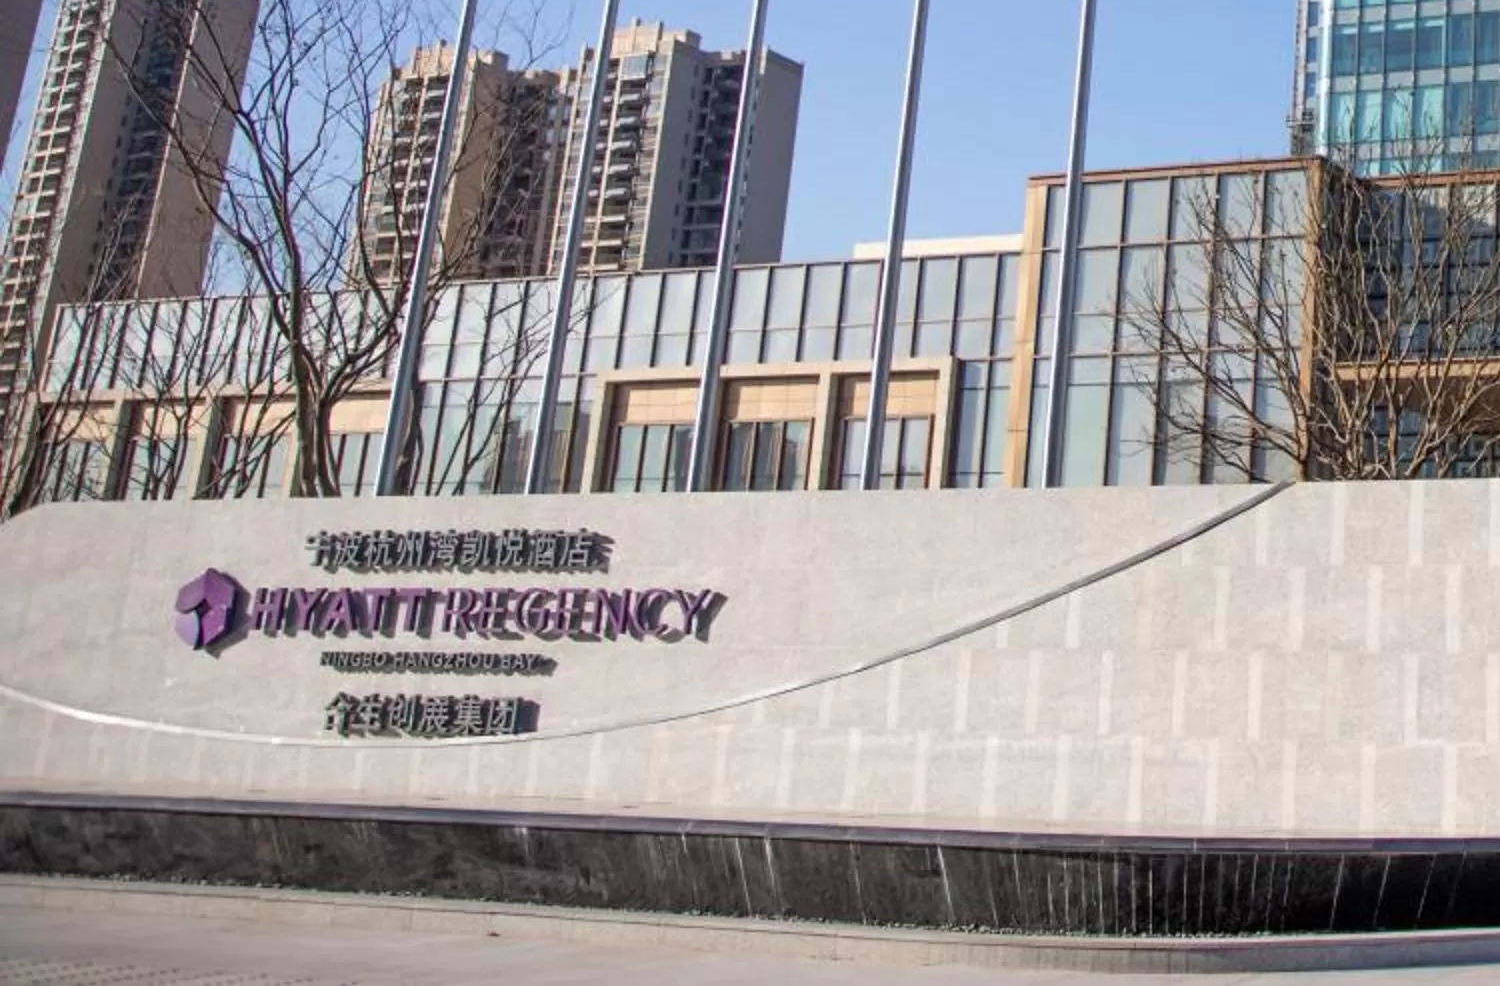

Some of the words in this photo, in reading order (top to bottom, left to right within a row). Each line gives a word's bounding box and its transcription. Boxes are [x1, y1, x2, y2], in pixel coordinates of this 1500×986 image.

[304, 529, 594, 567] 宁波杭州湾凯悦酒店
[250, 587, 433, 633] HYATT
[442, 587, 711, 641] REGENCY
[320, 651, 386, 667] NINGBO
[393, 652, 494, 670] HANGZHOU
[500, 653, 536, 671] BAY
[324, 692, 520, 735] 合生创展集团
